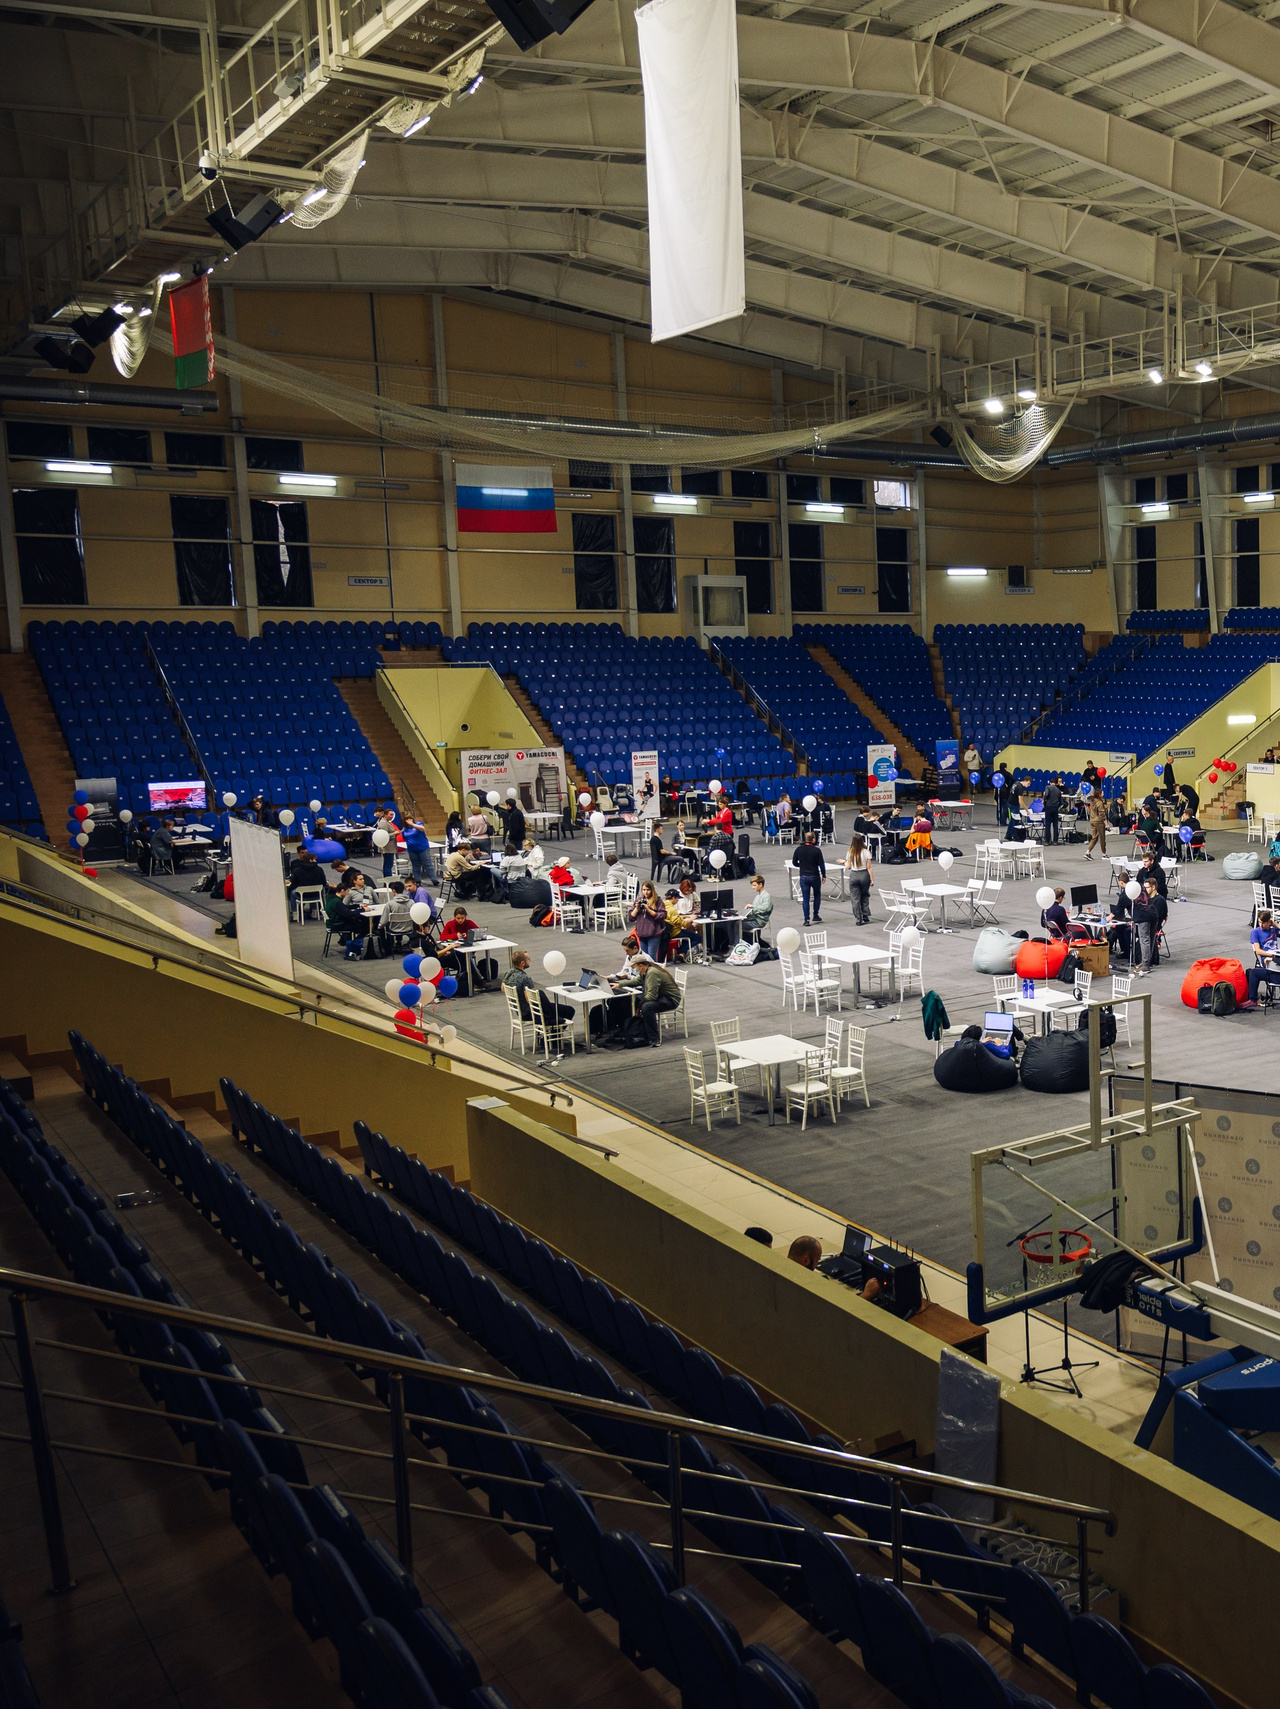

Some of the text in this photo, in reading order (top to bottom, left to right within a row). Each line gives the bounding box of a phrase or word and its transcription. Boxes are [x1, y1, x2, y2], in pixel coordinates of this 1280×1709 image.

[493, 752, 510, 760] СВОЙ
[468, 760, 505, 769] ДОМАШНИЙ
[469, 767, 508, 775] ФИТНЕС-ЗАЛ
[1241, 1358, 1274, 1375] ports
